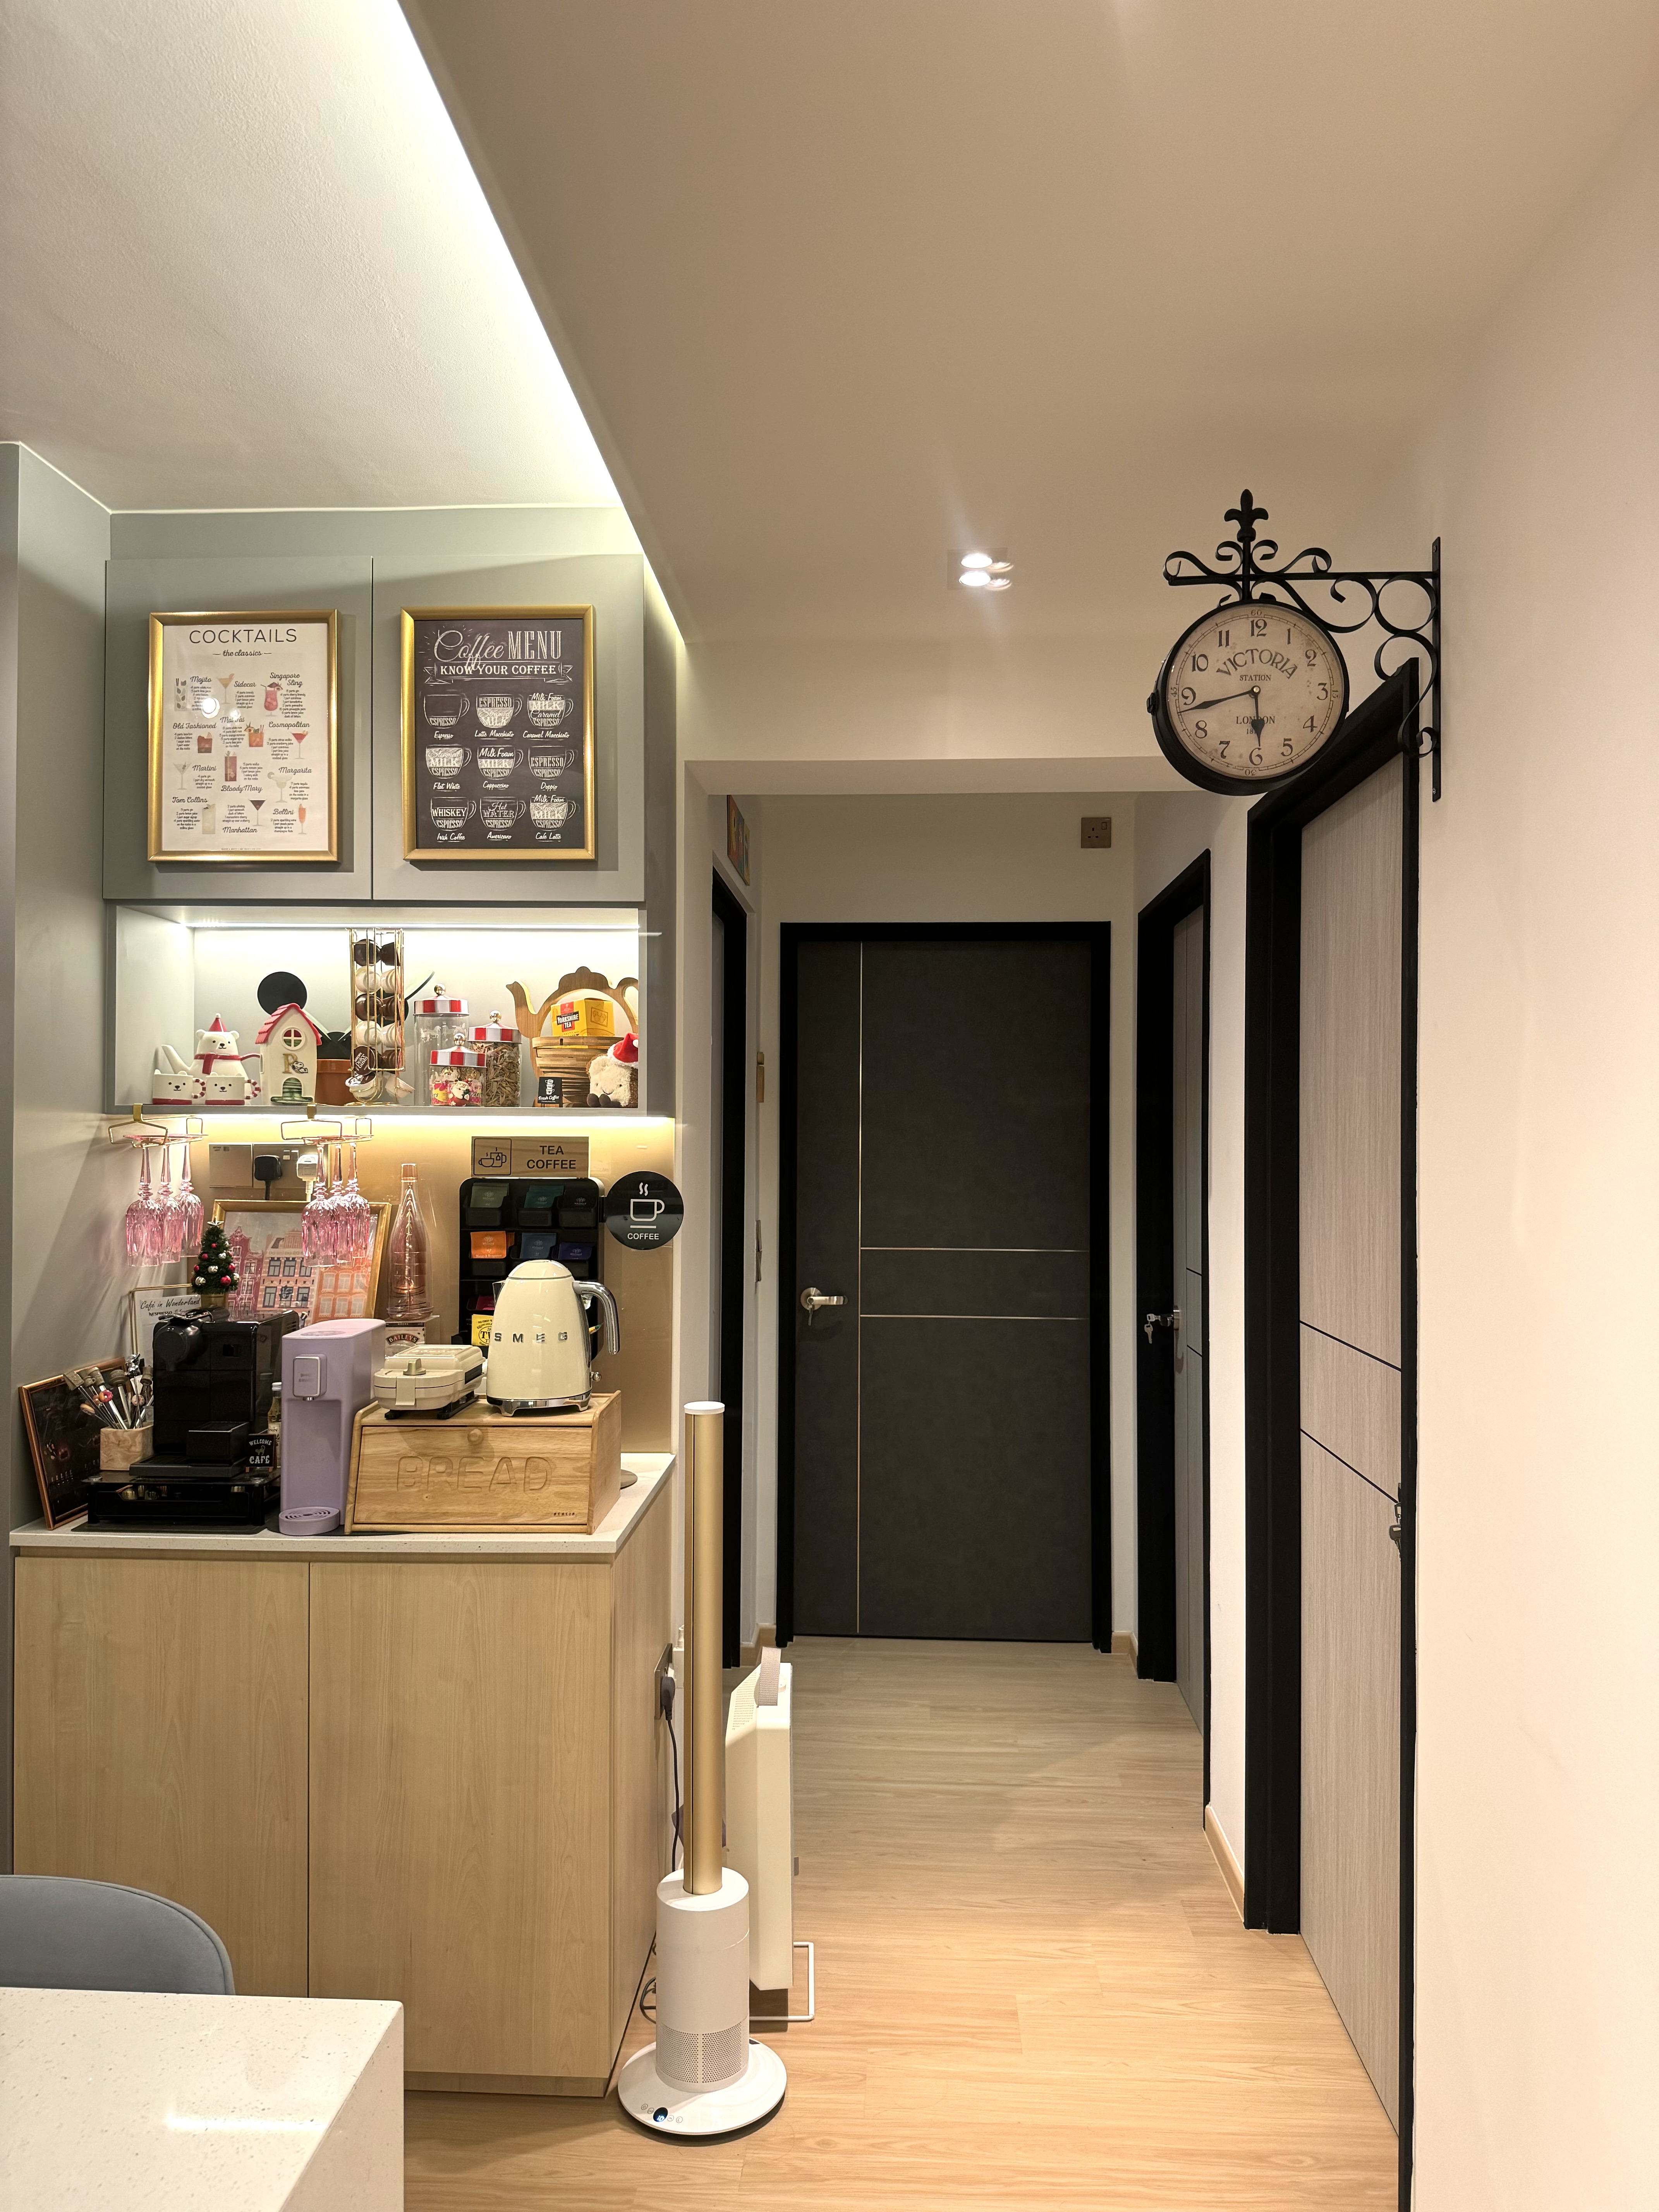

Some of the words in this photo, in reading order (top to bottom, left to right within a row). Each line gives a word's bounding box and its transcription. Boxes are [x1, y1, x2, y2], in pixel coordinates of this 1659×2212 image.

[1250, 619, 1267, 637] 12
[189, 629, 297, 643] COCKTAILS
[1218, 630, 1230, 647] 11
[1287, 628, 1291, 644] 1
[434, 630, 504, 670] Coffee
[508, 631, 562, 659] MENU
[1305, 649, 1316, 666] 2
[1192, 654, 1208, 672] 10
[1216, 648, 1298, 679] VICTORIA
[440, 665, 473, 675] KNOW
[477, 665, 508, 675] YOUR
[512, 665, 556, 675] COFFEE
[190, 676, 212, 684] Mojito
[270, 672, 300, 680] Singapore
[287, 679, 303, 687] Sling
[1182, 687, 1196, 705] 9
[1317, 683, 1328, 700] 3
[479, 697, 512, 708] ESPRESSO
[532, 701, 562, 710] MILK
[531, 710, 562, 718] Caramel
[429, 718, 456, 726] ESPRESSO
[533, 718, 560, 726] ESPRESSO
[1303, 715, 1317, 732] 4
[1195, 720, 1207, 738] 8
[1219, 741, 1230, 759] 7
[1281, 738, 1293, 756] 5
[479, 748, 496, 757] Milk
[497, 748, 514, 757] Foam
[1249, 748, 1262, 766] 6
[430, 758, 458, 766] MILK
[482, 759, 510, 768] MILK
[531, 757, 563, 767] ESPRESSO
[278, 767, 313, 775] Margarita
[431, 768, 458, 776] ESPRESSO
[483, 769, 510, 777] ESPRESSO
[534, 769, 560, 778] ESPRESSO
[483, 781, 509, 790] Cappuccino
[541, 782, 558, 791] Doppio
[488, 802, 507, 811] Hot
[432, 807, 467, 817] WHISKEY
[535, 811, 563, 819] MILK
[436, 820, 463, 828] ESPRESSO
[485, 819, 512, 828] ESPRESSO
[536, 820, 562, 829] ESPRESSO
[557, 1014, 579, 1024] YORKSHIRE
[539, 1145, 564, 1155] TEA
[527, 1159, 576, 1170] COFFEE
[141, 1300, 155, 1311] Café
[166, 1298, 201, 1307] Wonderland
[389, 1334, 417, 1343] BAILEYS
[397, 1456, 552, 1494] BREAD
